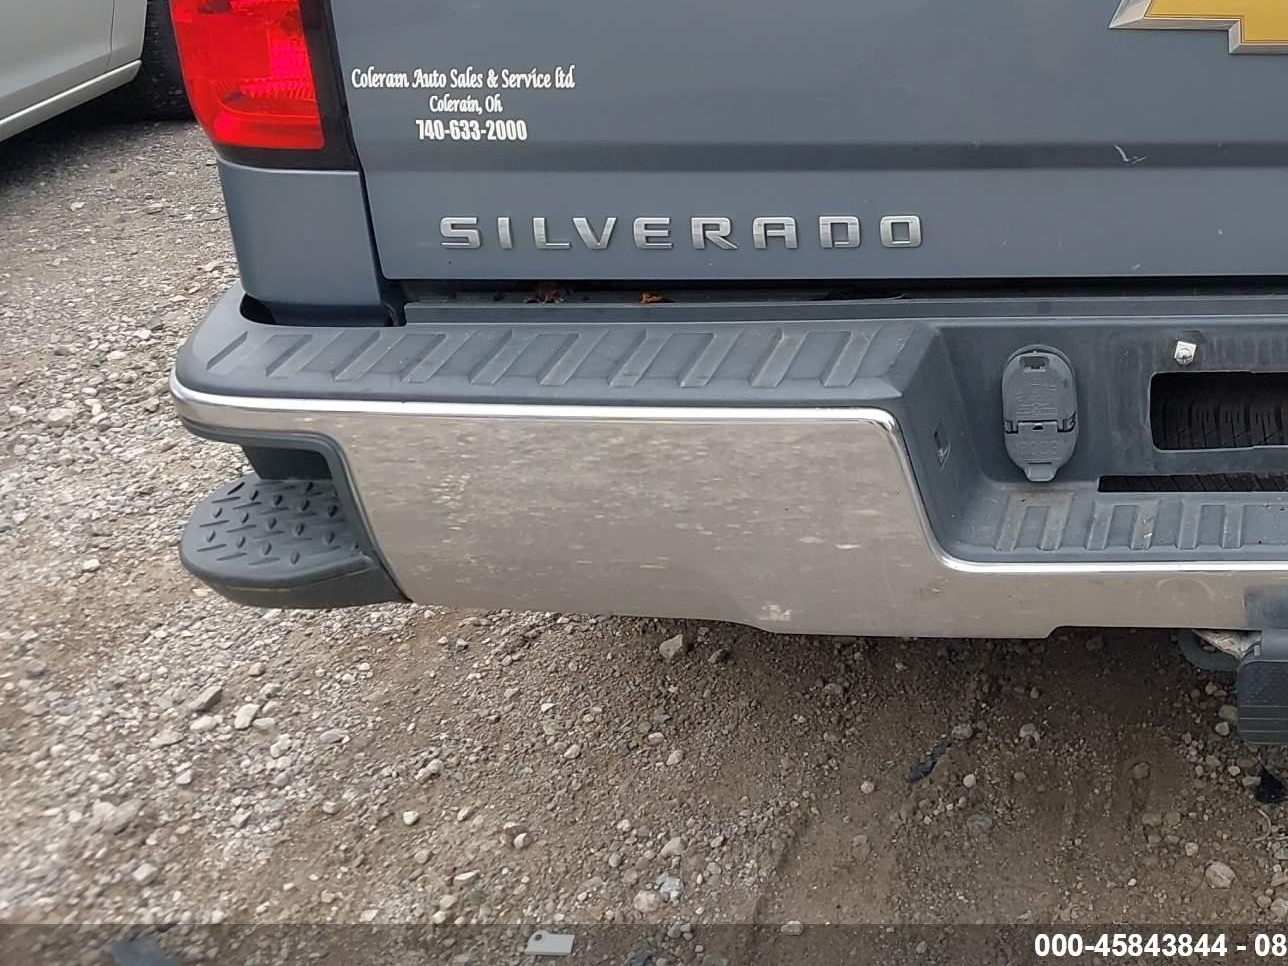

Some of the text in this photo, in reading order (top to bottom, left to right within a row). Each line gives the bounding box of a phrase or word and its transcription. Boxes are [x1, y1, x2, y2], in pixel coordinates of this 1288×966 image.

[411, 68, 447, 88] Auto
[449, 66, 484, 89] Sales
[486, 68, 499, 88] &
[501, 68, 552, 89] Service
[429, 93, 503, 115] Colerain, Oh
[415, 119, 528, 141] 740-633-2000
[439, 215, 922, 249] SILVERADO
